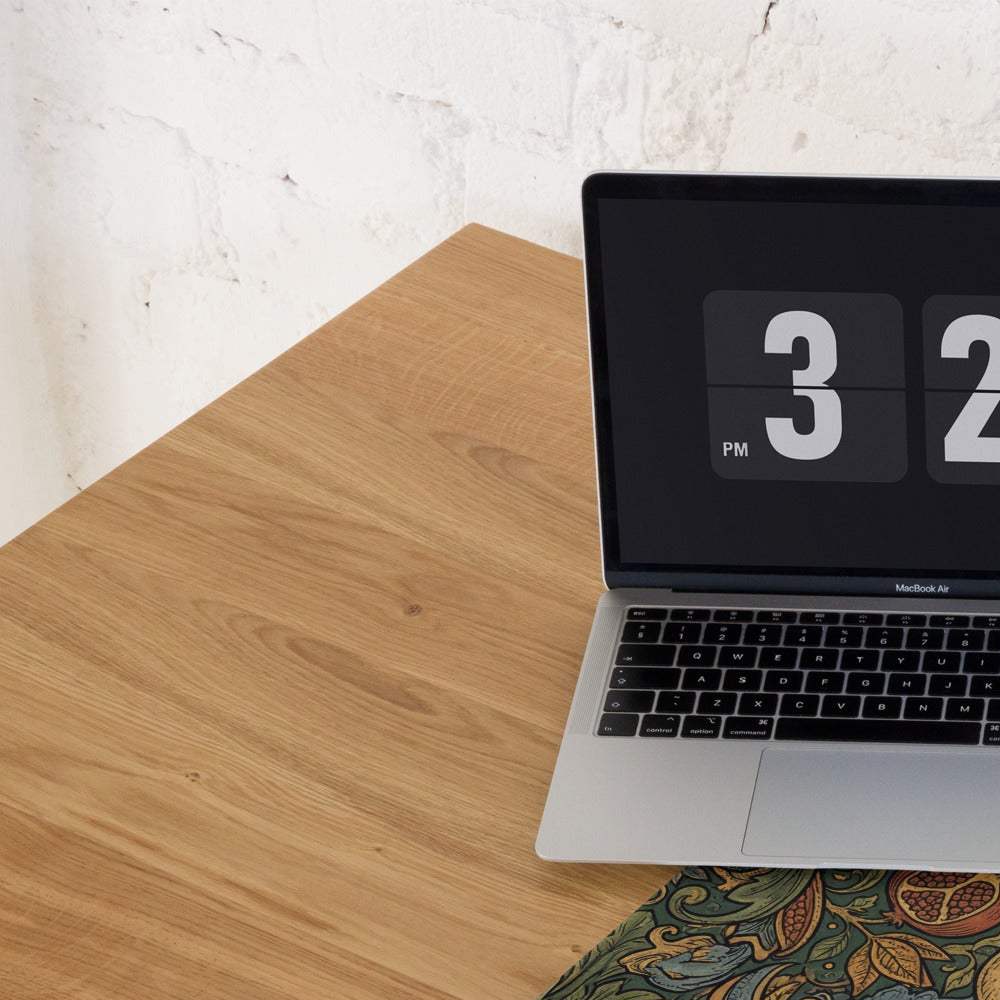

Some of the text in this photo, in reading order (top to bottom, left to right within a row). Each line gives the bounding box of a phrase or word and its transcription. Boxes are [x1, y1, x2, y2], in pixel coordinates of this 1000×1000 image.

[764, 310, 843, 460] 3
[722, 441, 749, 457] PM
[895, 583, 950, 593] MacBook Air
